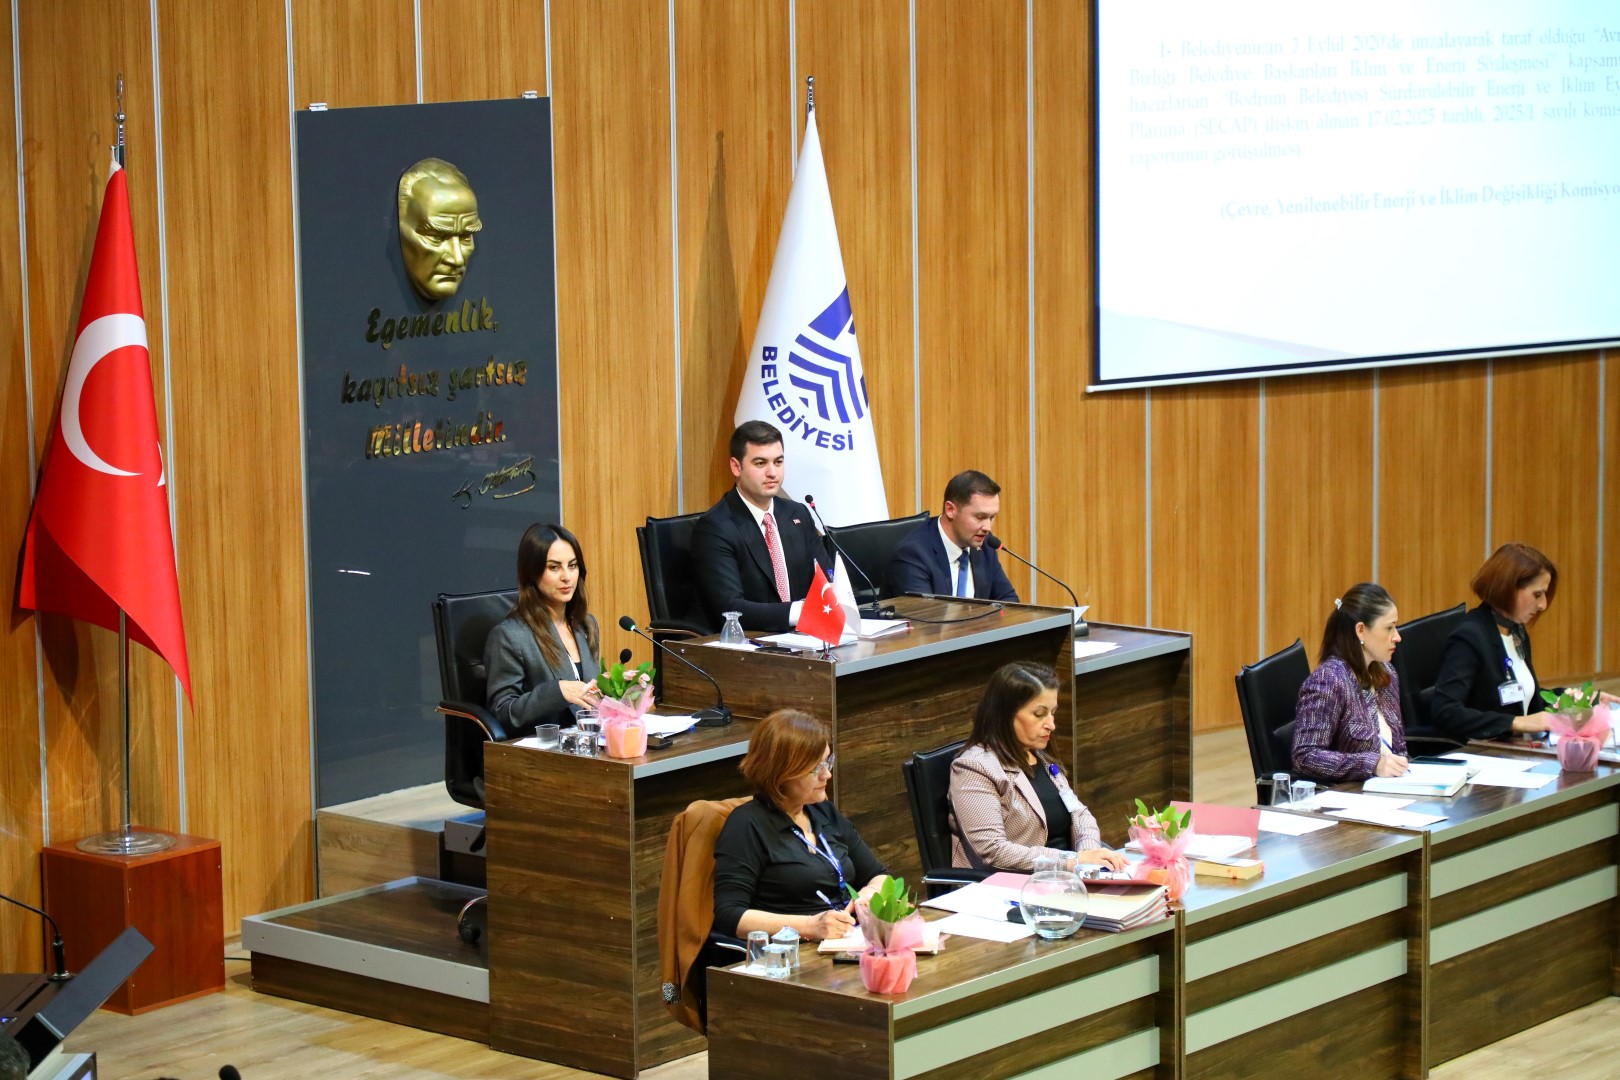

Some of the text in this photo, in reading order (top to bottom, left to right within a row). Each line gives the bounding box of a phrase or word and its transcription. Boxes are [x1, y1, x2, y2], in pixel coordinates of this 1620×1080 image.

[1502, 28, 1534, 47] taraf
[1539, 27, 1585, 48] olduğu
[1189, 64, 1253, 86] Belediye
[1264, 60, 1339, 83] Başkanları
[1398, 62, 1416, 75] ve
[1425, 56, 1466, 76] Enerji
[1128, 92, 1209, 113] hazırlanan
[1299, 85, 1369, 107] Belediyesi
[1487, 79, 1526, 101] Enerji
[1536, 81, 1552, 95] ve
[1316, 111, 1361, 130] alınan
[1277, 193, 1370, 215] Yenilenebilir
[1373, 189, 1416, 215] Enerji
[1419, 193, 1437, 206] ve
[1440, 184, 1479, 206] İklim
[1482, 181, 1558, 208] Değişikliği
[341, 355, 528, 408] kayıtsız şartsız
[761, 346, 854, 451] BELEDİYESİ
